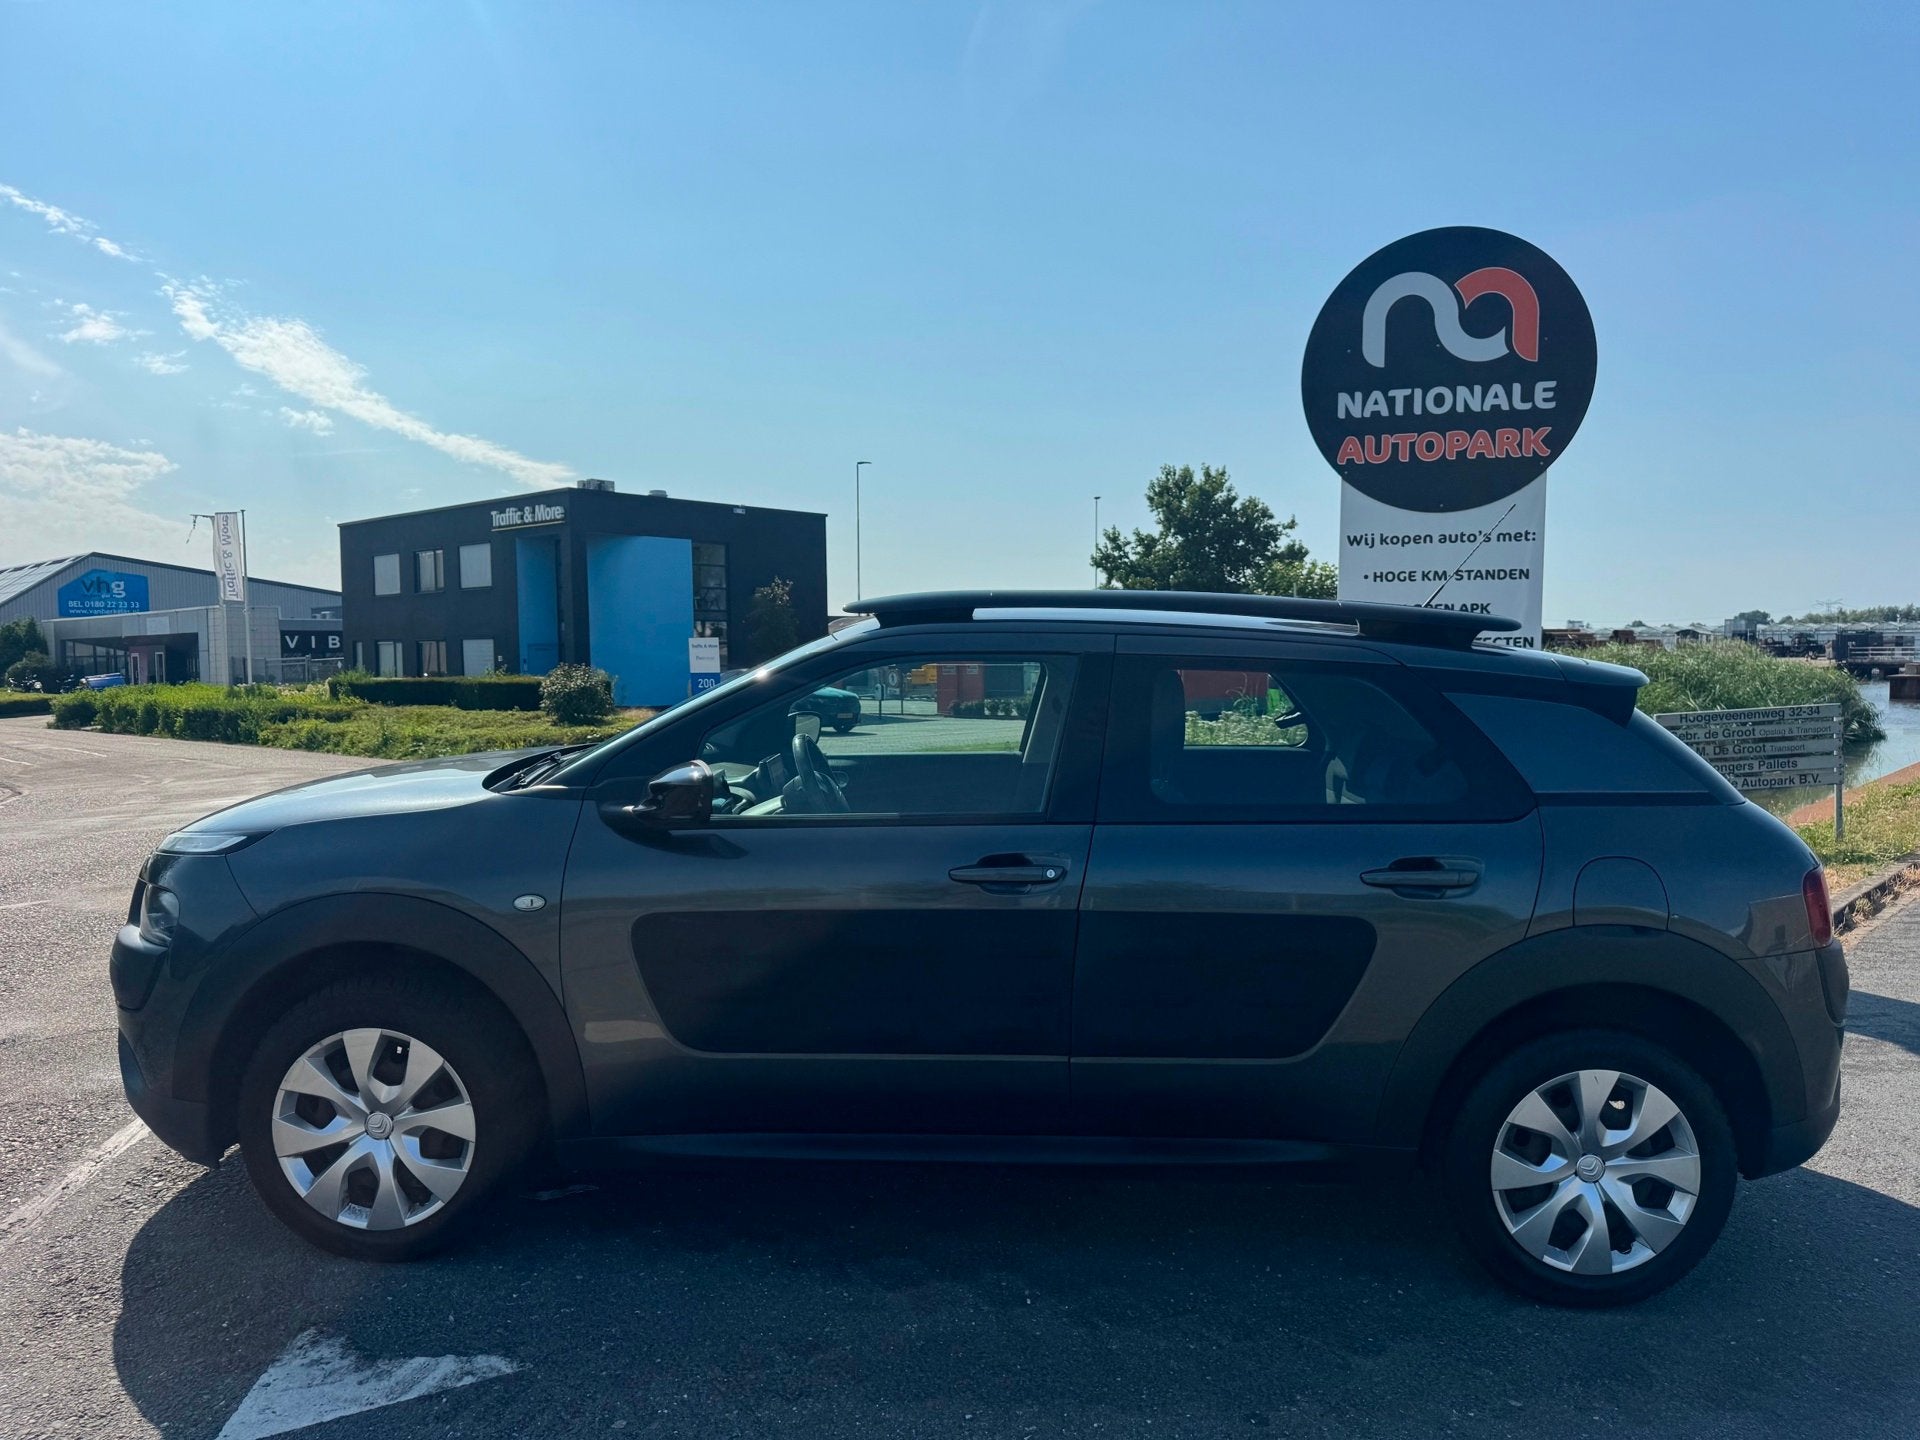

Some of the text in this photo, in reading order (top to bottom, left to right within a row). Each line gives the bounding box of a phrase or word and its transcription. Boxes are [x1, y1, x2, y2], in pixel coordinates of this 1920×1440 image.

[1337, 380, 1558, 420] NATIONALE
[1337, 427, 1552, 466] AUTOPARK
[491, 504, 565, 527] Traffic & More
[1346, 530, 1536, 549] Wij kopen auto's met:
[1373, 571, 1417, 582] HOGE
[81, 577, 126, 598] vhg
[68, 600, 84, 608] BEL
[1459, 603, 1491, 614] APK
[698, 678, 716, 688] 200
[1789, 705, 1821, 717] 32-34
[1704, 729, 1719, 740] de
[1722, 727, 1756, 739] Groot
[1713, 745, 1729, 756] De
[1732, 743, 1767, 755] Groot
[1758, 759, 1798, 770] Pallets
[1741, 775, 1796, 789] Autopark
[1799, 773, 1822, 785] B.V.
